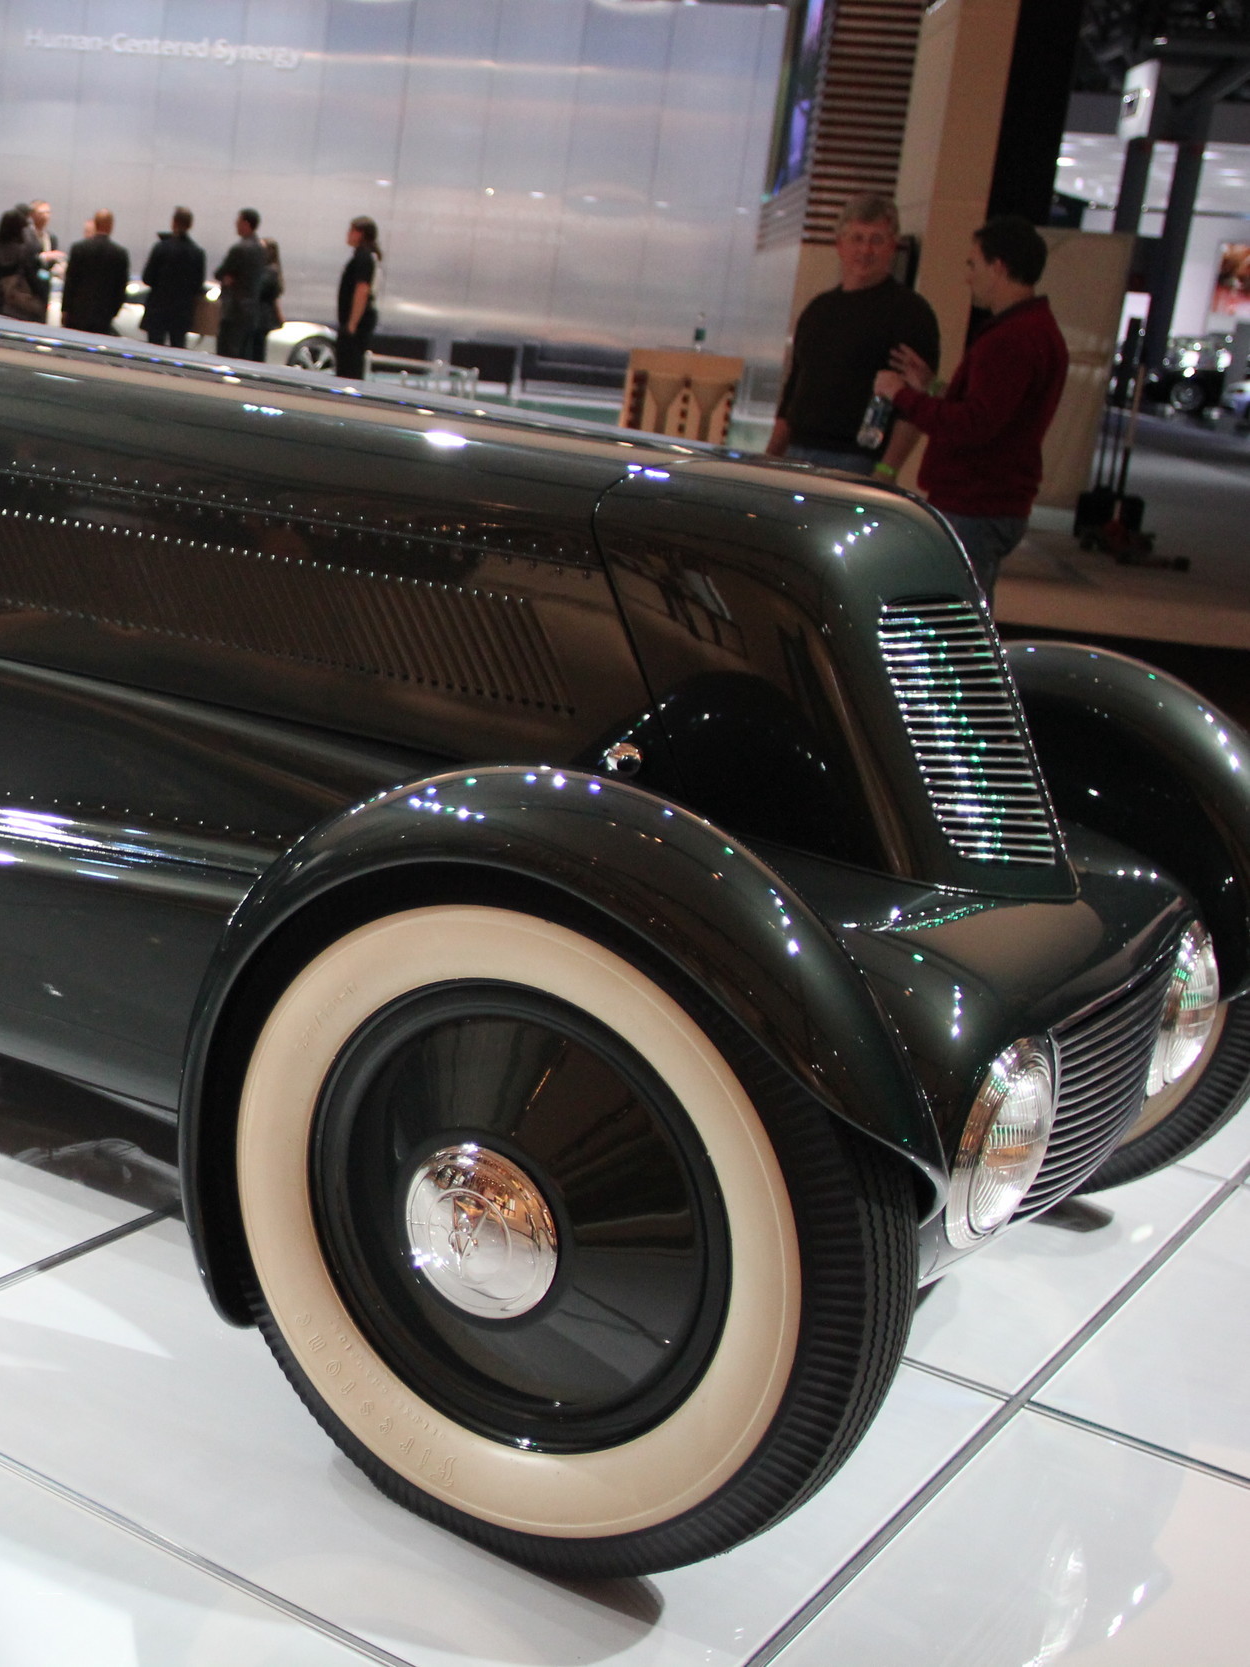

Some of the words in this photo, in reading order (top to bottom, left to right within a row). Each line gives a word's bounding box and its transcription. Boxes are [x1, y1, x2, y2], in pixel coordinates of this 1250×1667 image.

[24, 28, 210, 58] Human-Centered
[213, 38, 301, 70] Synergy
[293, 1312, 457, 1487] Firestone
